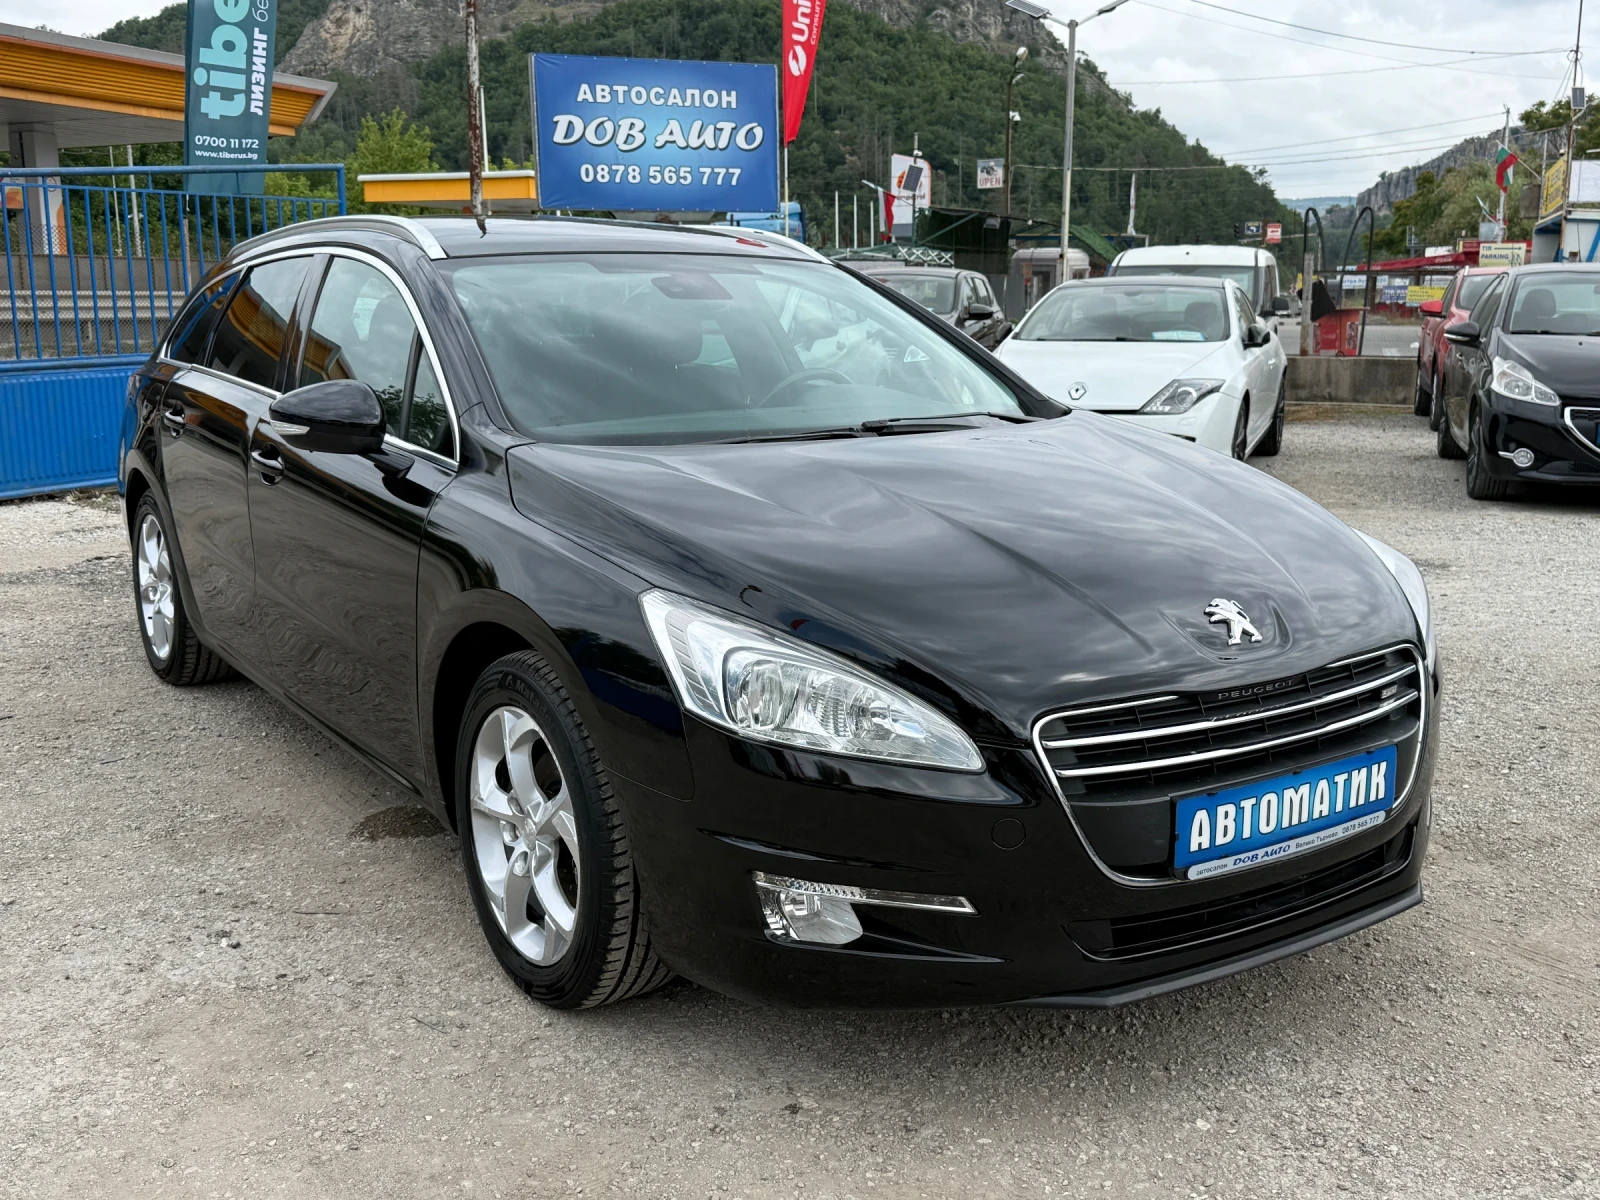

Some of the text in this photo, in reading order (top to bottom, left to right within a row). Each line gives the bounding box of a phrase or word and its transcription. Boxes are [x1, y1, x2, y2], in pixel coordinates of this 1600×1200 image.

[193, 0, 250, 120] tibe
[576, 83, 738, 109] АВТОСАЛОН
[194, 135, 259, 149] 0700 11 172
[552, 114, 764, 152] DOB AUTO
[194, 149, 259, 160] www.tiberus.bg
[580, 163, 742, 187] 0878 565 777
[1218, 679, 1295, 700] PEUGEOT
[1188, 760, 1388, 854] АВТОМАТИК
[1341, 824, 1356, 835] 0878
[1357, 819, 1368, 830] 565
[1368, 815, 1380, 826] 777
